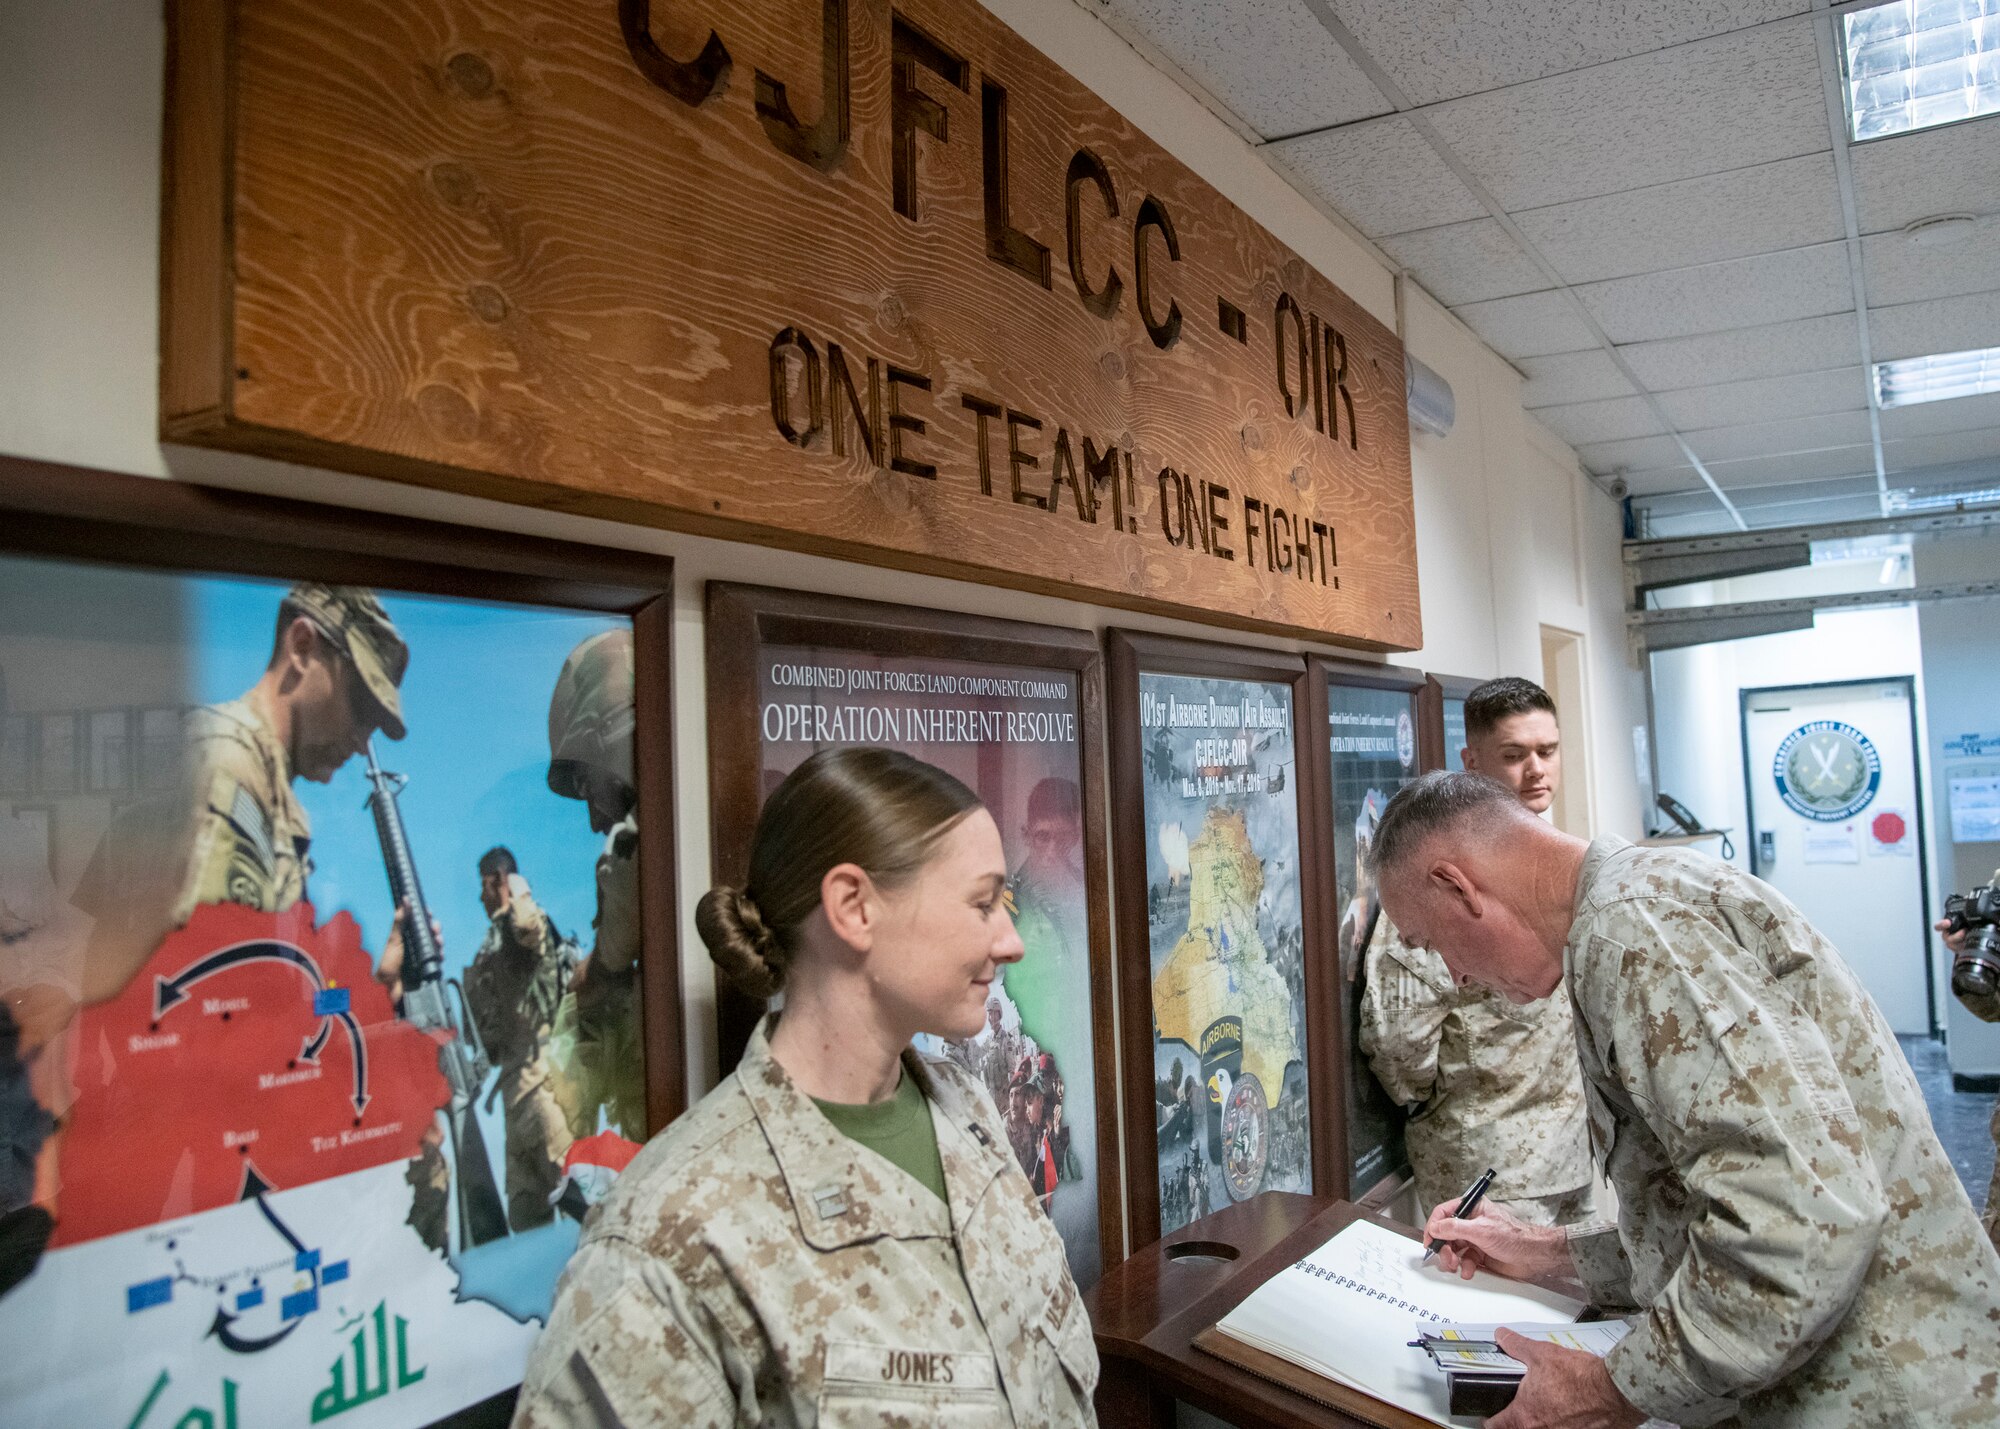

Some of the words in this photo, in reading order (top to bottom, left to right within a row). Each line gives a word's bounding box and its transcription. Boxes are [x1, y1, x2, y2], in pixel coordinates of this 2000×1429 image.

[1274, 291, 1358, 451] OIR
[769, 325, 938, 481] ONE
[962, 393, 1138, 535] TEAM!
[1158, 466, 1234, 561] ONE
[1244, 495, 1340, 590] FIGHT!
[771, 663, 845, 689] COMBINED
[848, 669, 882, 696] JOINT
[884, 671, 926, 693] FORCES
[928, 674, 957, 695] LAND
[958, 676, 1020, 698] COMPONENT
[1021, 680, 1068, 700] COMMAND
[763, 702, 901, 742] OPERATION
[906, 708, 1002, 742] INHERENT
[1006, 711, 1075, 743] RESOLVE
[1195, 739, 1248, 767] CJFLCC-OIR
[1205, 776, 1219, 796] 2016
[1202, 1022, 1241, 1056] AIRBORNE
[881, 1352, 954, 1383] JONES
